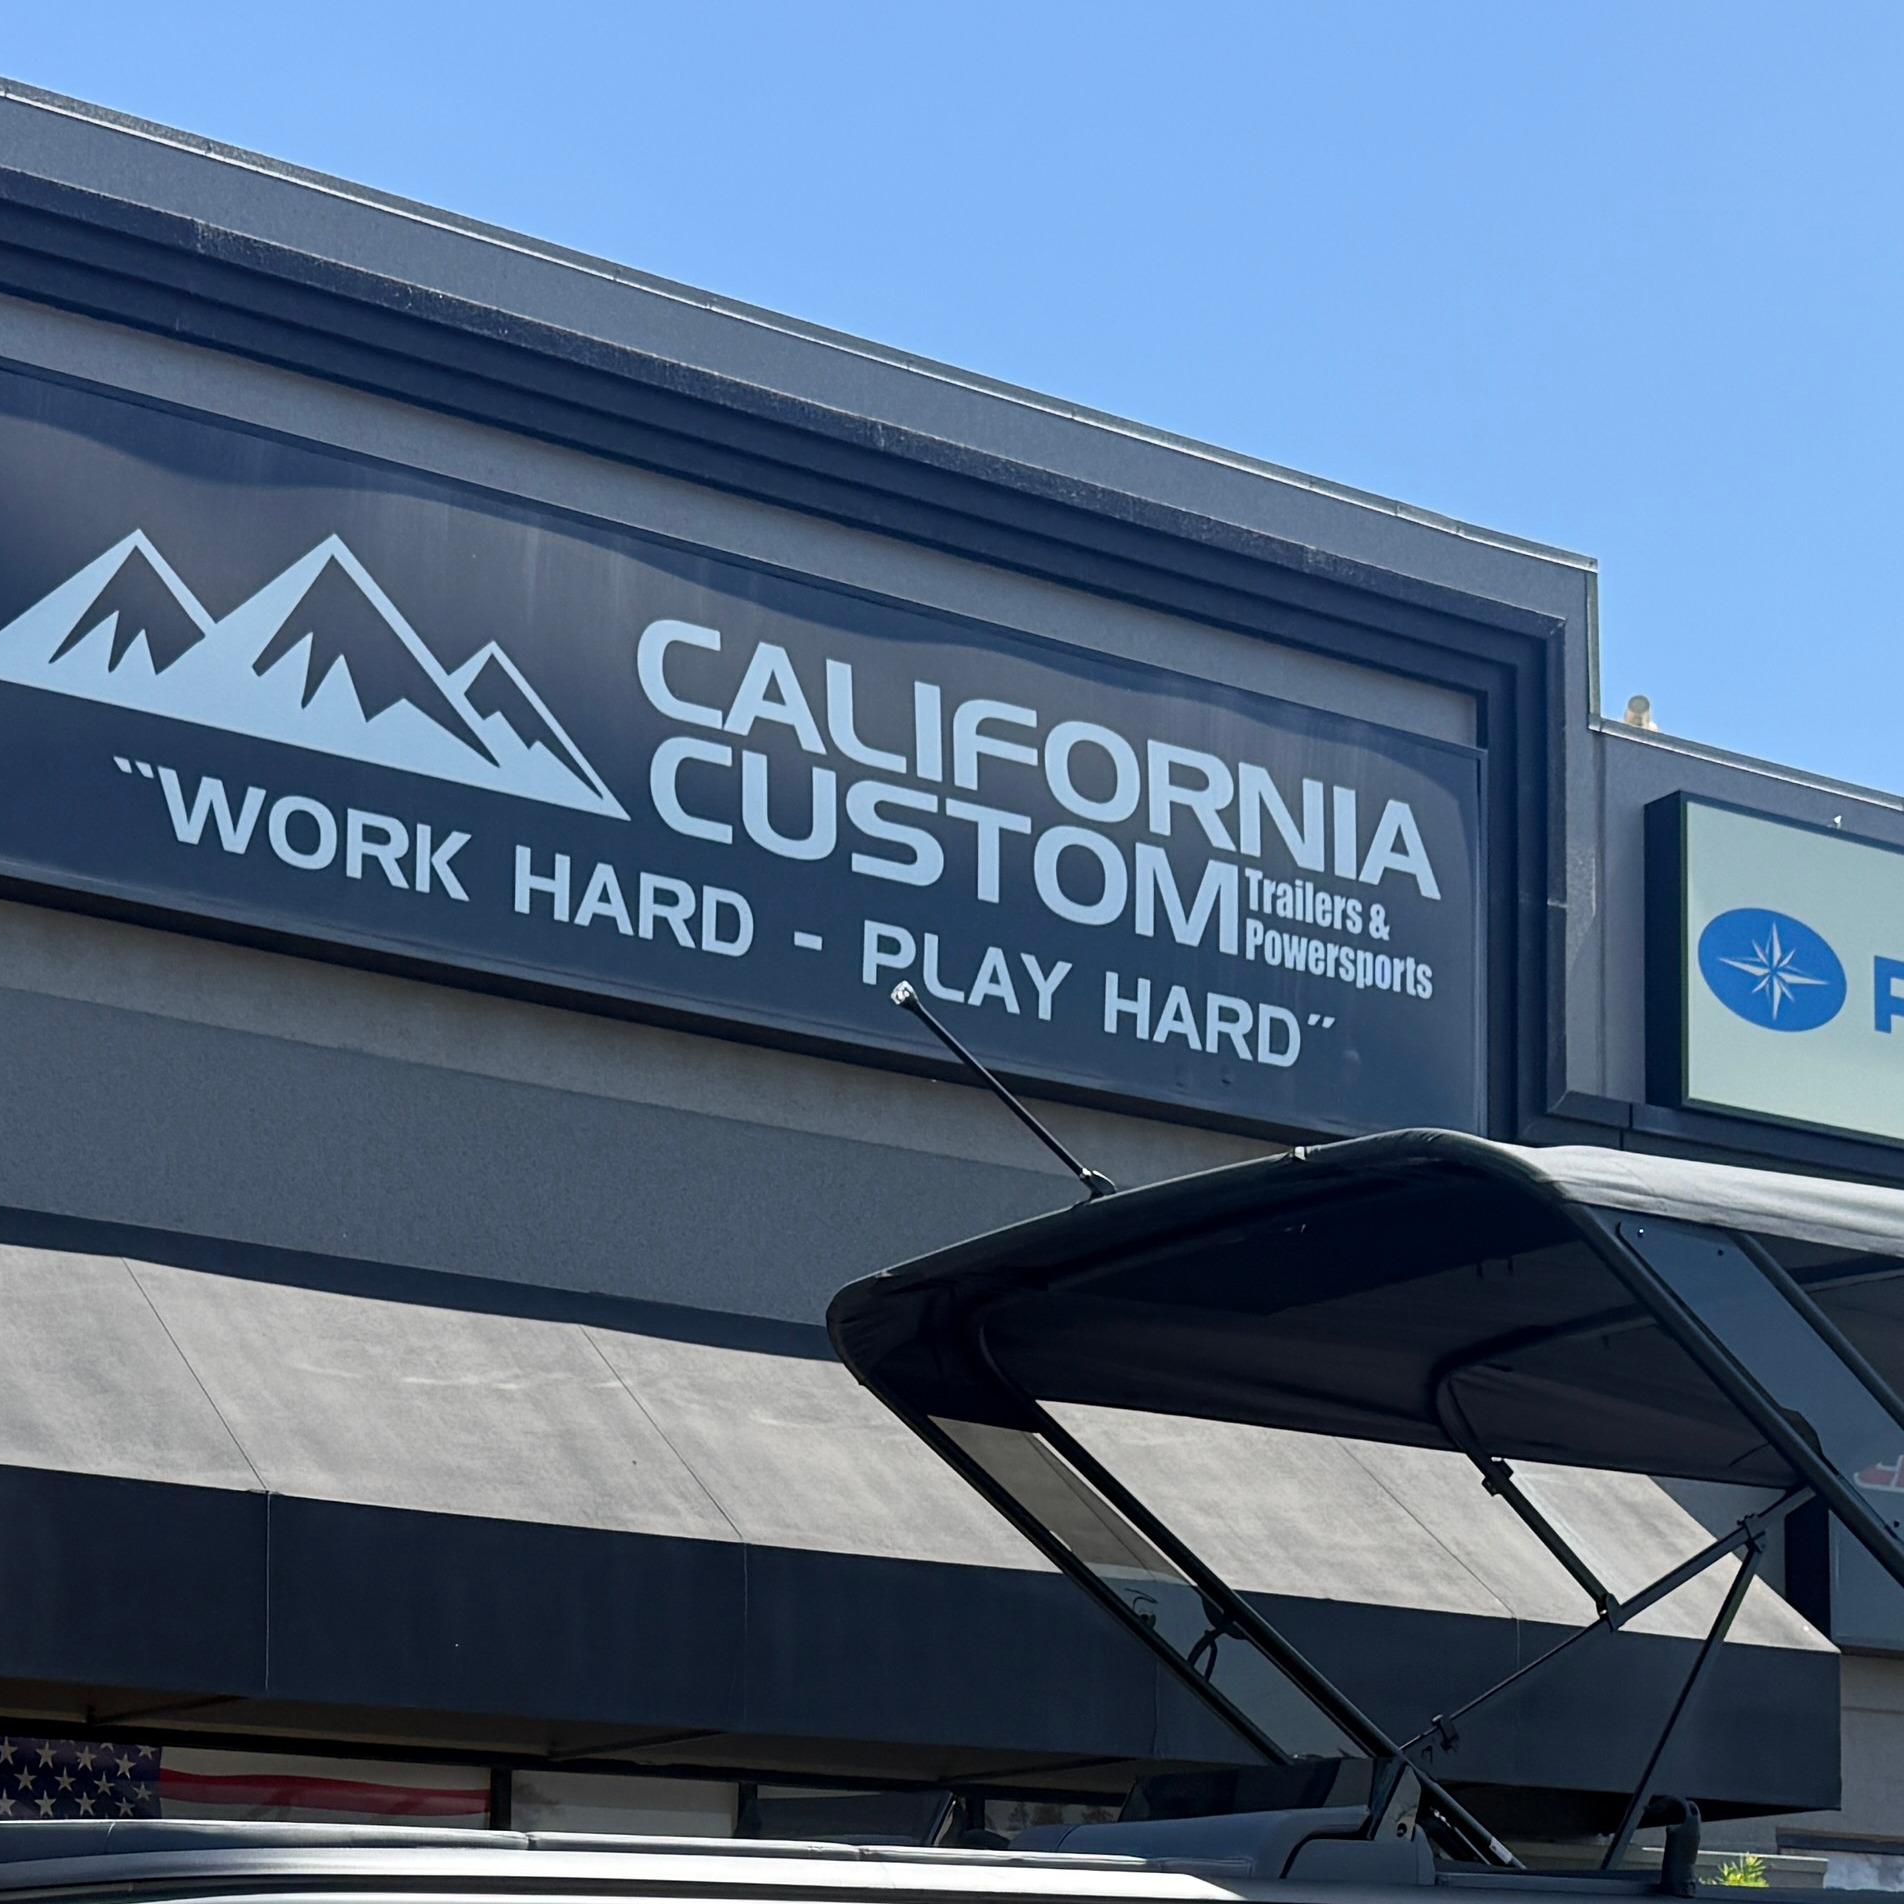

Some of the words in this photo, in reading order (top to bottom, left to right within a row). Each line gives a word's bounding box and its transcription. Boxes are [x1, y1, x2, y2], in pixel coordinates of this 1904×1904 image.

[636, 618, 1443, 902] CALIFORNIA
[650, 736, 1239, 957] CUSTOM
[514, 844, 755, 958] HARD
[862, 919, 1074, 1022] PLAY
[1244, 867, 1363, 936] Trailers
[1368, 903, 1391, 941] &
[1245, 917, 1434, 1000] Powersports
